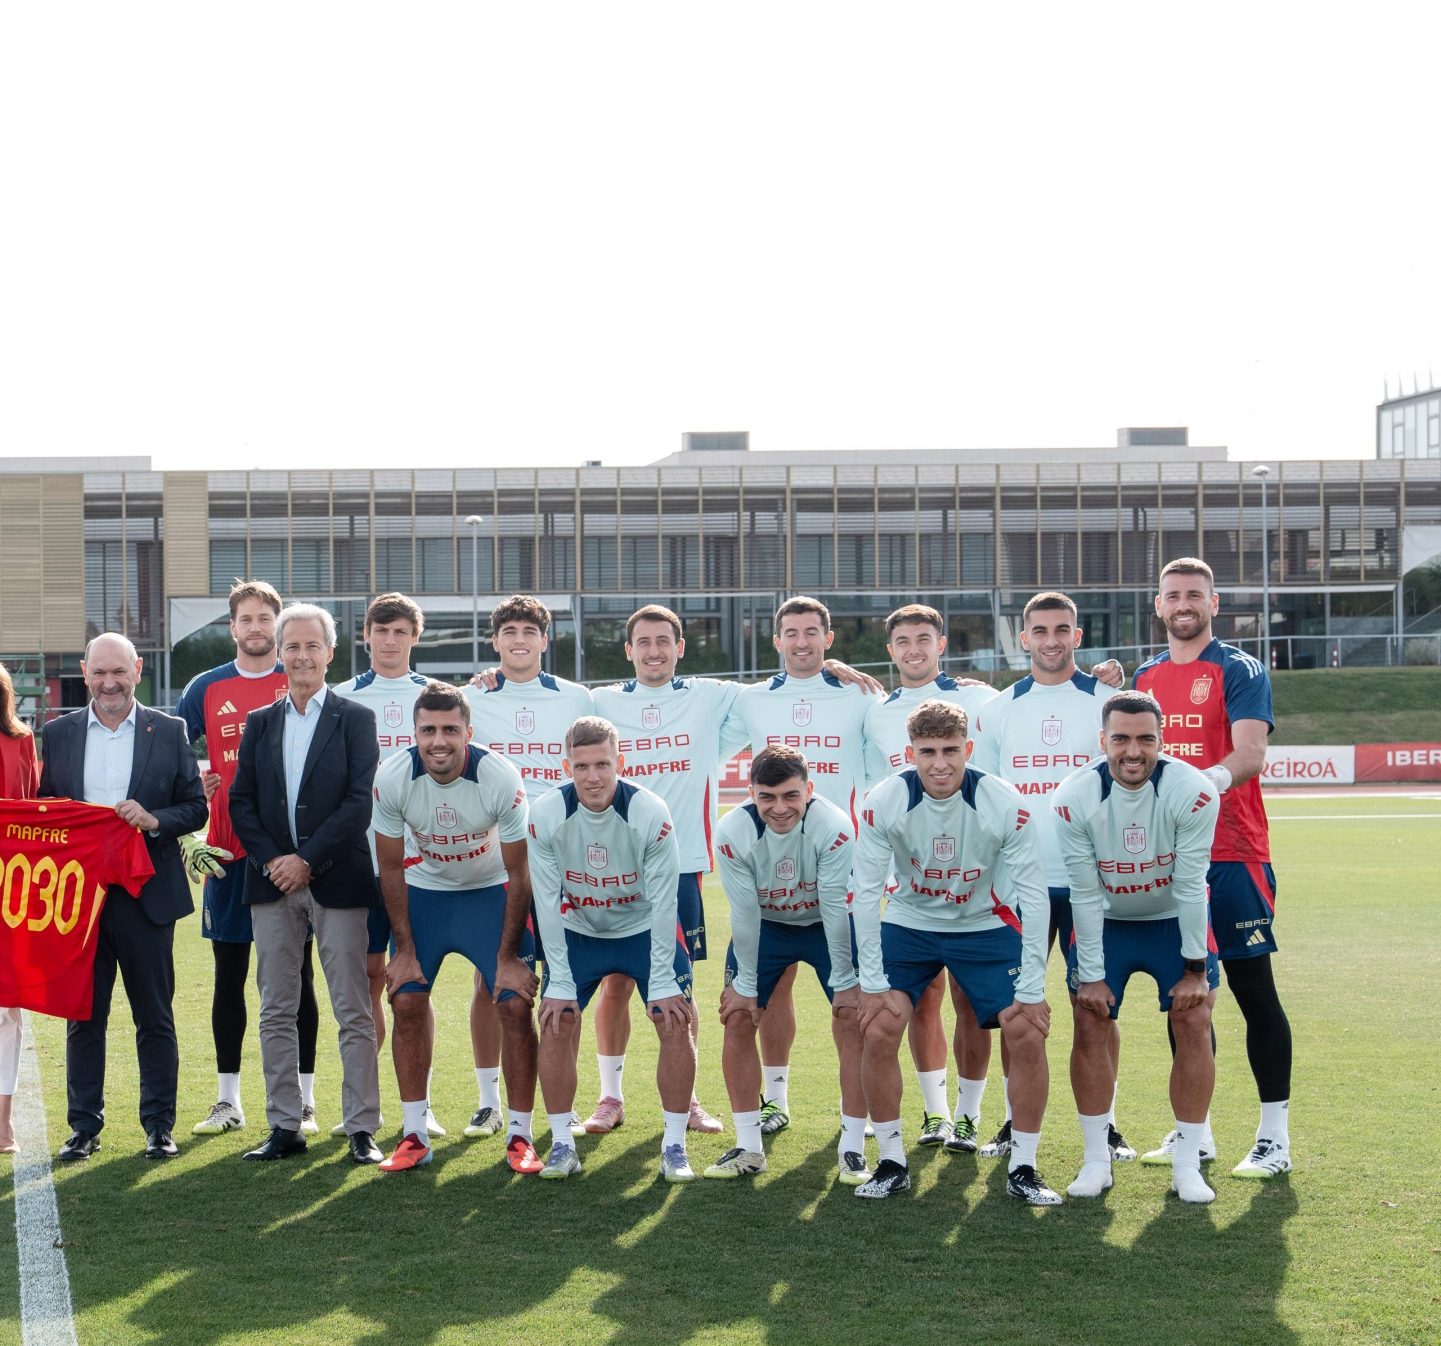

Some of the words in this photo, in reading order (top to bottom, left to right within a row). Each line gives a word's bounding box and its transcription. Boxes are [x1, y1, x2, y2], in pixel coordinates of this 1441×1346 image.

[1160, 714, 1203, 728] RO
[618, 734, 690, 752] EBRO
[767, 735, 841, 748] EBRO
[489, 743, 562, 755] EBRO
[1162, 743, 1204, 757] PFRE
[1013, 755, 1090, 768] EBRO
[1387, 750, 1441, 767] IBER
[521, 767, 562, 780] PFRE
[621, 759, 691, 777] MAPFRE
[807, 762, 839, 774] FRE
[1014, 782, 1061, 794] MAP
[7, 824, 69, 844] MAPFRE
[415, 831, 489, 845] EBRO
[1097, 853, 1173, 874] EBRO
[566, 870, 638, 887] EBRO
[567, 892, 642, 909] MAPFRE
[760, 900, 819, 911] APFR
[1236, 918, 1270, 929] EBRO
